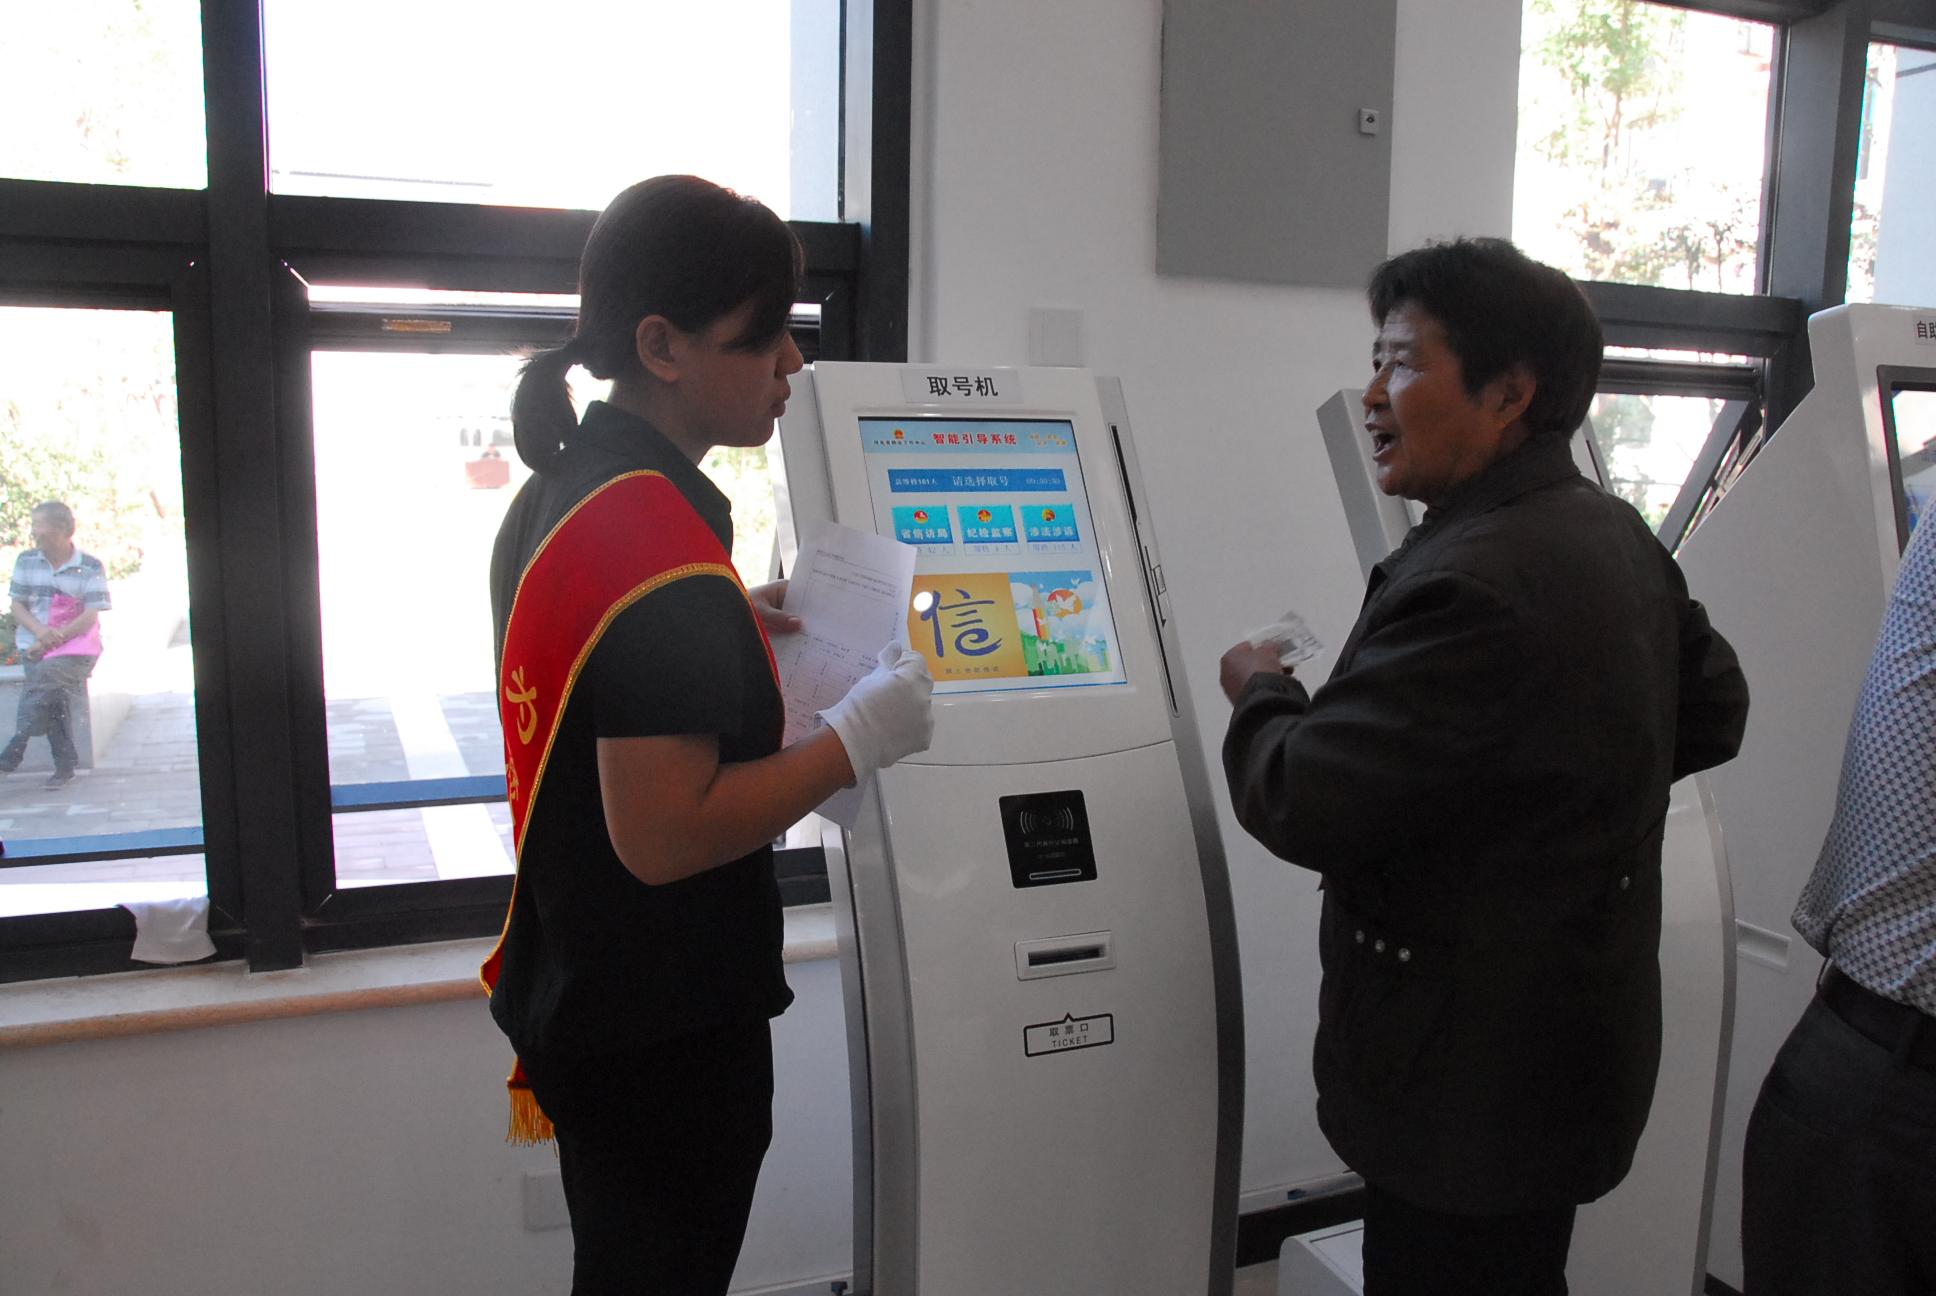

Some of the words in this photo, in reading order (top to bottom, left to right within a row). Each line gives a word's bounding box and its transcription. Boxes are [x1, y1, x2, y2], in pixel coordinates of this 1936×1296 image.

[927, 376, 999, 397] 取号机
[932, 432, 1018, 445] 智能引导系统
[952, 475, 1009, 487] 请选择取号
[901, 526, 949, 539] 省信访局
[967, 526, 1013, 538] 纪检监察
[920, 588, 1003, 658] 信
[1051, 1036, 1089, 1048] TICKET
